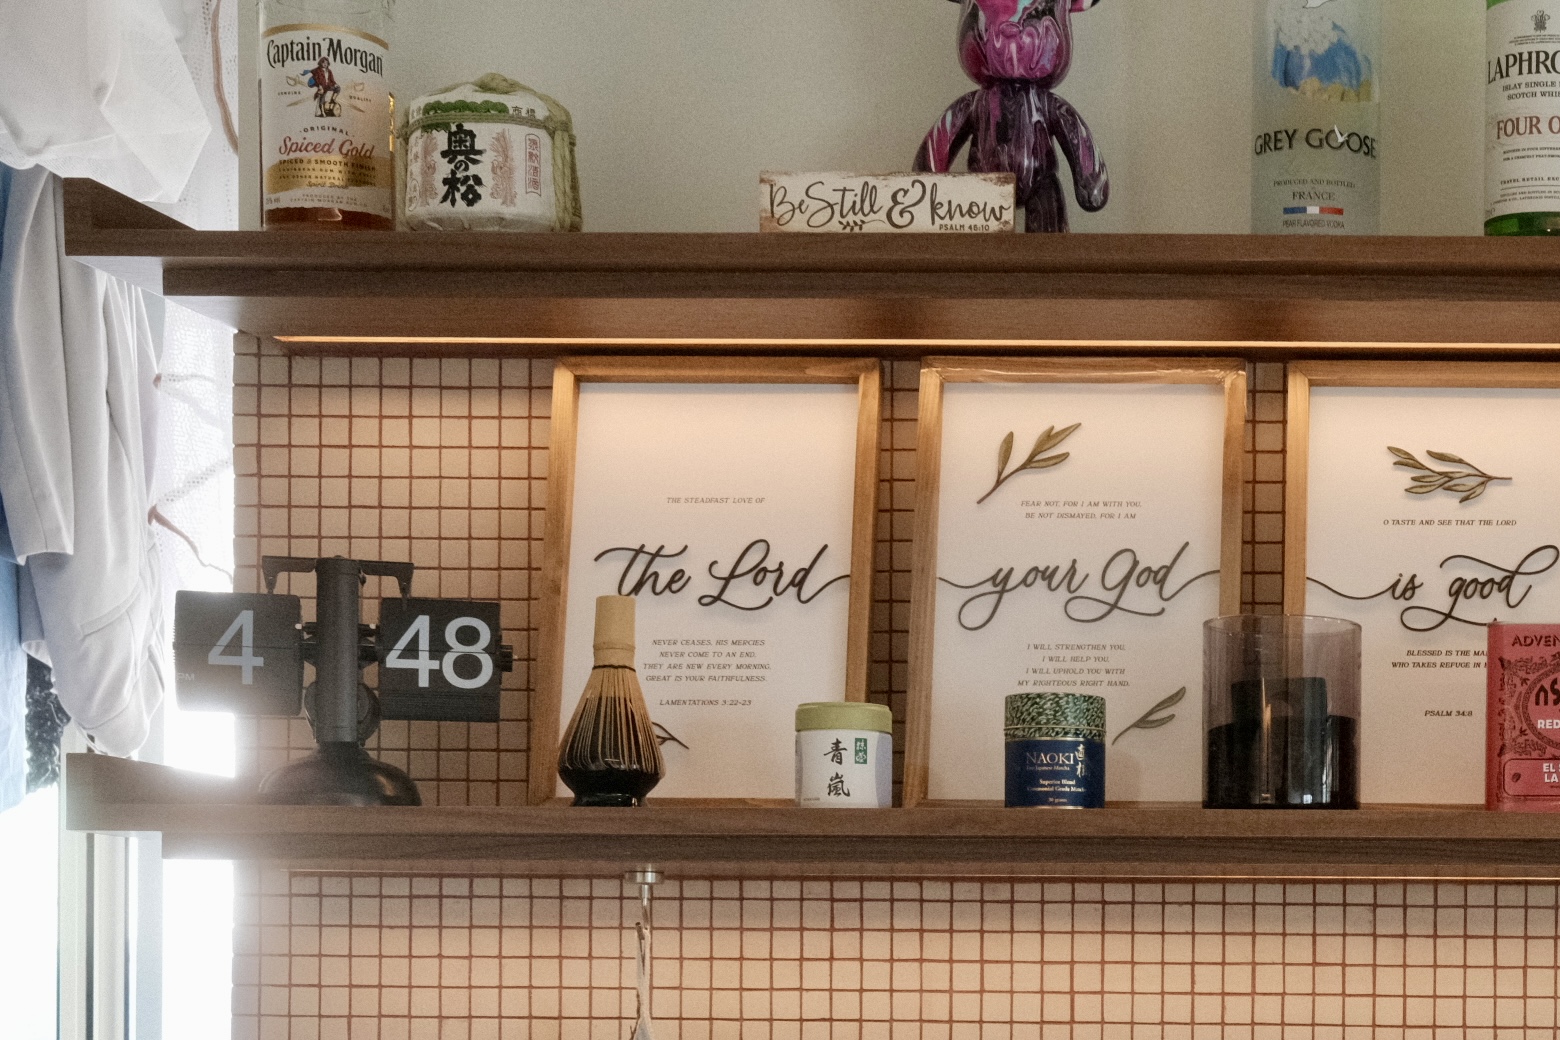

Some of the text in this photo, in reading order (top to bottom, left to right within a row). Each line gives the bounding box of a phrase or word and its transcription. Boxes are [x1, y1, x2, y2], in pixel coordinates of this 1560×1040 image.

[266, 36, 384, 78] Captain Morgan
[1502, 83, 1523, 92] ISLAY
[1524, 80, 1557, 89] SINGLE
[1507, 91, 1537, 101] SCOTCH
[303, 125, 350, 136] ORIGINAL
[1496, 115, 1543, 140] FOUR
[278, 135, 376, 159] Spiced Gold
[1254, 128, 1376, 159] GREY GOOSE
[314, 159, 349, 168] SMOOTH
[440, 122, 487, 208] 奥の松
[1273, 179, 1308, 187] PRODUCED
[1292, 191, 1335, 201] FRANCE
[769, 179, 1012, 230] Be Still & know
[938, 223, 967, 232] PSALM
[594, 538, 850, 611] the Lord
[1400, 544, 1560, 632] good
[938, 558, 1089, 631] your
[207, 609, 494, 690] 4 48
[1026, 643, 1107, 651] I WILL STRENGTHEN
[1406, 649, 1488, 657] BLESSED IS THE MA
[1042, 655, 1091, 663] I WILL HELP
[1391, 661, 1410, 669] WHO
[1412, 661, 1437, 669] TAKES
[1439, 661, 1471, 669] REFUGE
[1473, 661, 1482, 669] IN
[1025, 667, 1126, 675] I WILL UPHOLD YOU WITH
[1026, 752, 1075, 765] NAOKI
[823, 737, 851, 798] 青嵐
[1542, 762, 1556, 773] EL
[1544, 773, 1559, 783] LA
